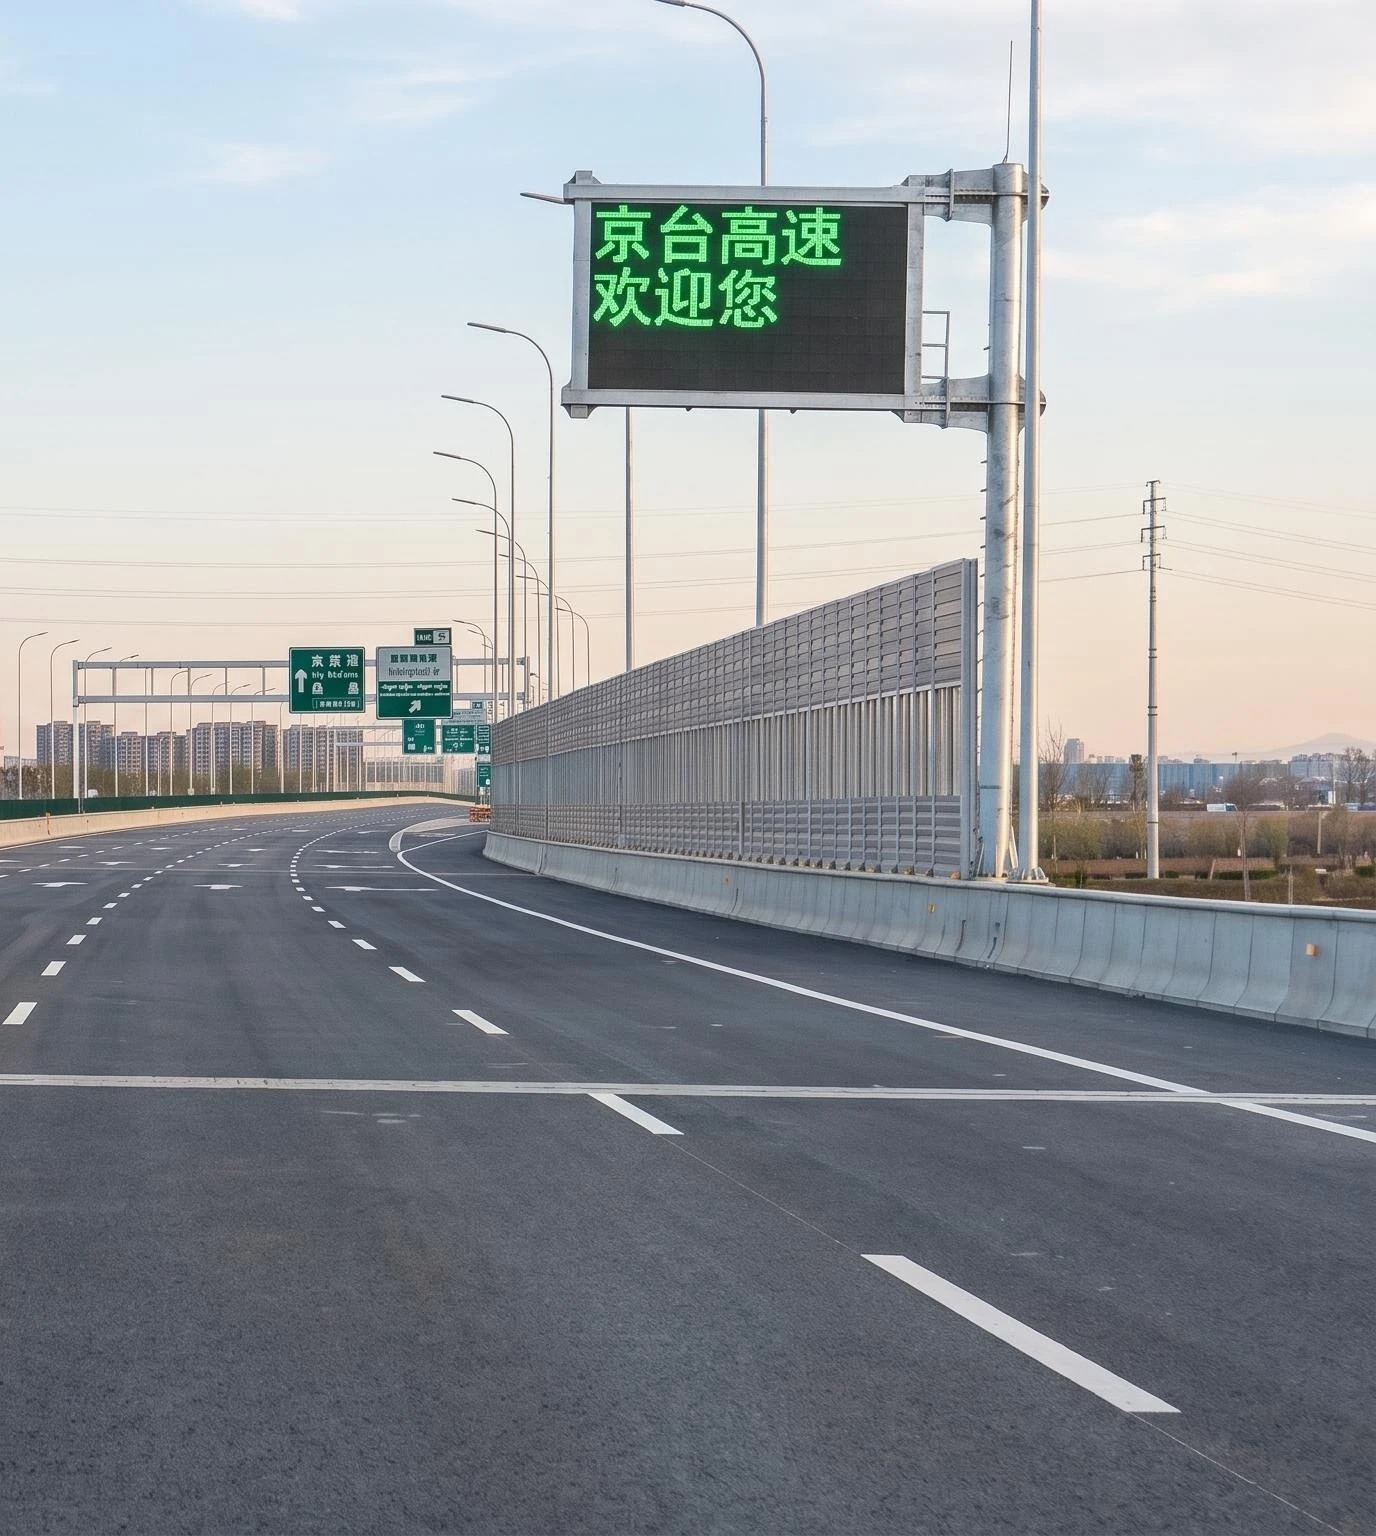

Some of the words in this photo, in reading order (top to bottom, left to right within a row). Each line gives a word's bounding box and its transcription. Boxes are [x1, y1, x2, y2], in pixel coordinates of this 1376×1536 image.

[595, 205, 842, 266] 京台高速
[593, 267, 778, 328] 欢迎您
